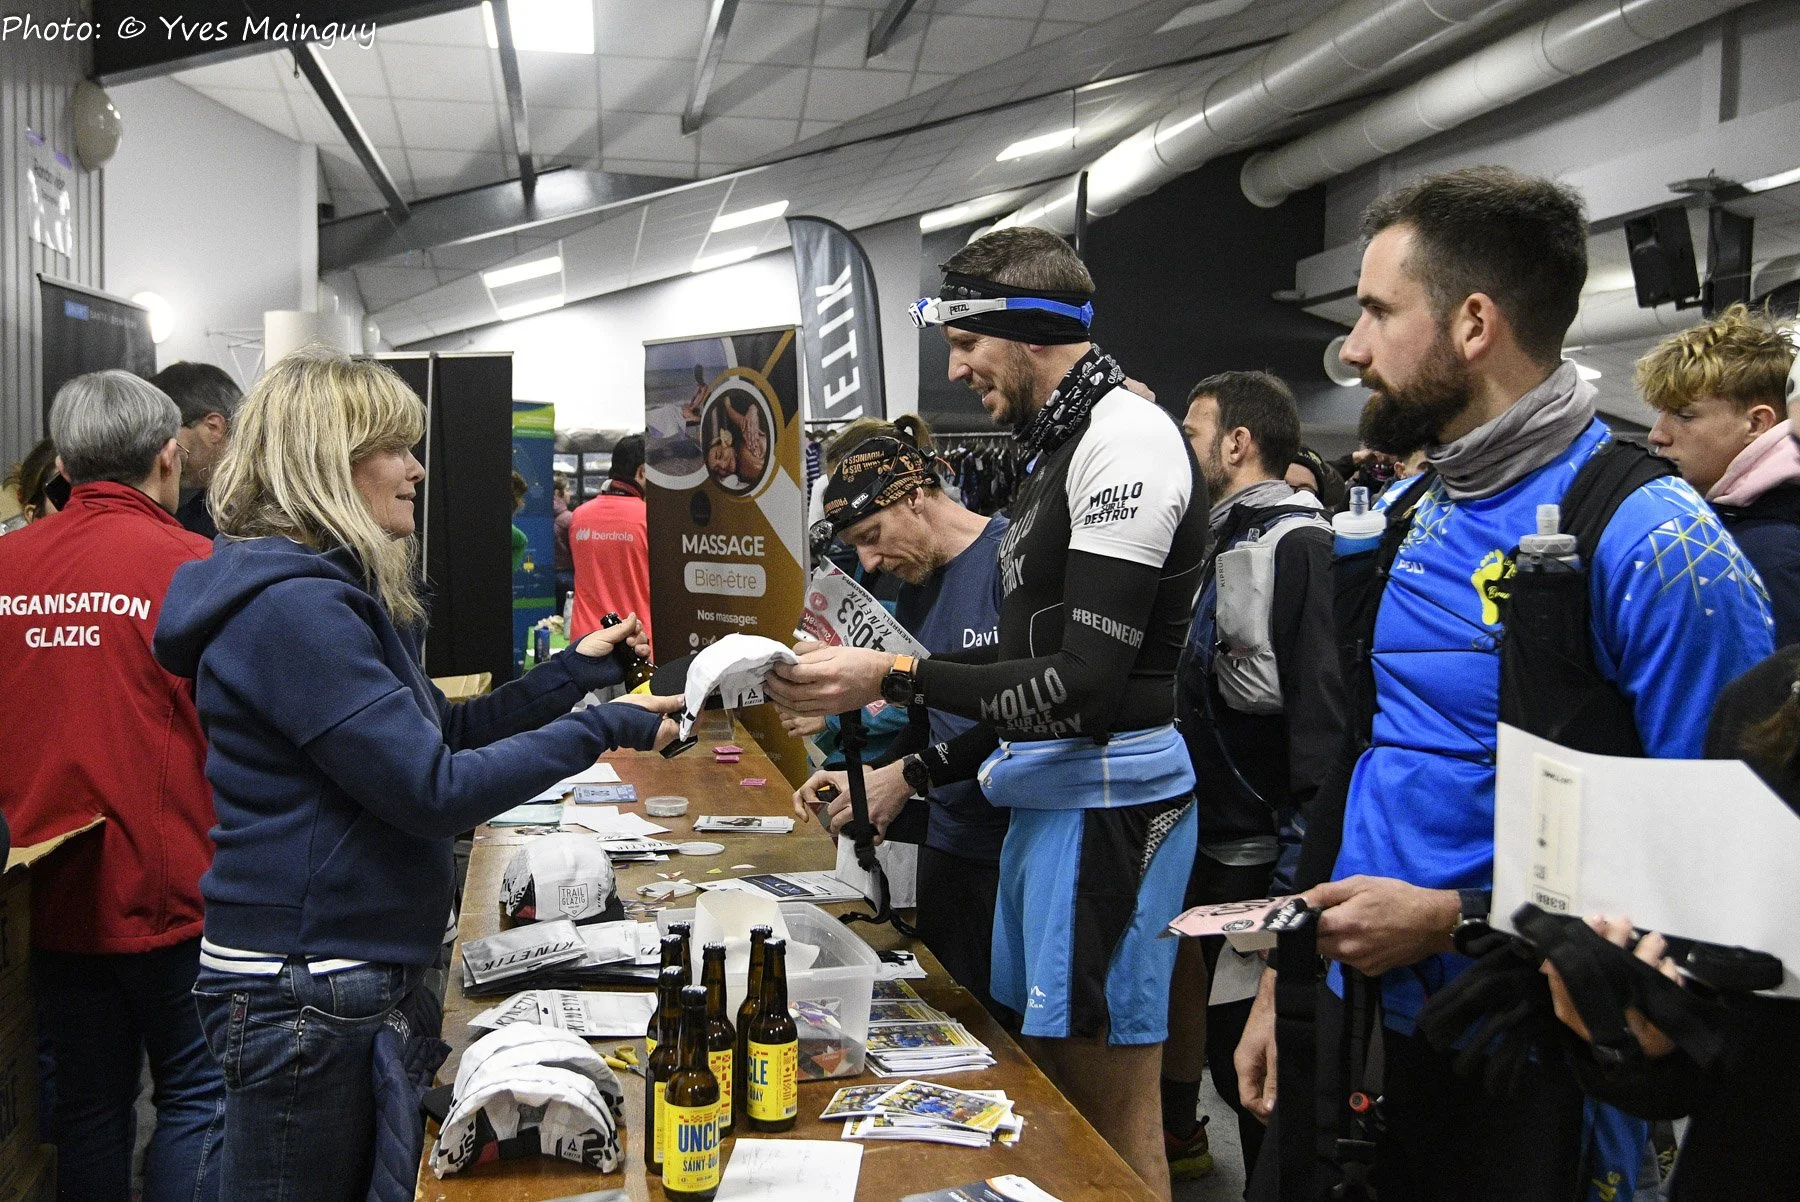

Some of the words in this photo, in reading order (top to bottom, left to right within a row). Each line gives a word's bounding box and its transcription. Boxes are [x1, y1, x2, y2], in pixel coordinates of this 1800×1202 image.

[949, 303, 970, 316] PETZL
[1089, 481, 1144, 509] MOLLO
[1084, 507, 1138, 526] DESTROY
[1100, 502, 1115, 513] SUR
[1116, 501, 1126, 509] LE
[682, 534, 766, 557] MASSAGE
[695, 568, 757, 590] Bien-être
[1217, 556, 1226, 588] KIPRUN
[697, 609, 715, 621] Nos
[715, 613, 758, 627] massages:
[837, 597, 886, 653] 4063
[846, 590, 893, 638] KINETIK
[25, 625, 100, 648] GLAZIG
[882, 612, 913, 644] MERRELL
[980, 666, 1068, 721] MOLLO
[1006, 717, 1033, 729] SUR
[1036, 708, 1054, 724] LE
[561, 888, 585, 898] TRAIL
[561, 896, 586, 906] GLAZIG
[483, 940, 575, 972] KINETIK
[496, 992, 538, 1027] KINETIK
[560, 993, 585, 1033] KINETIK
